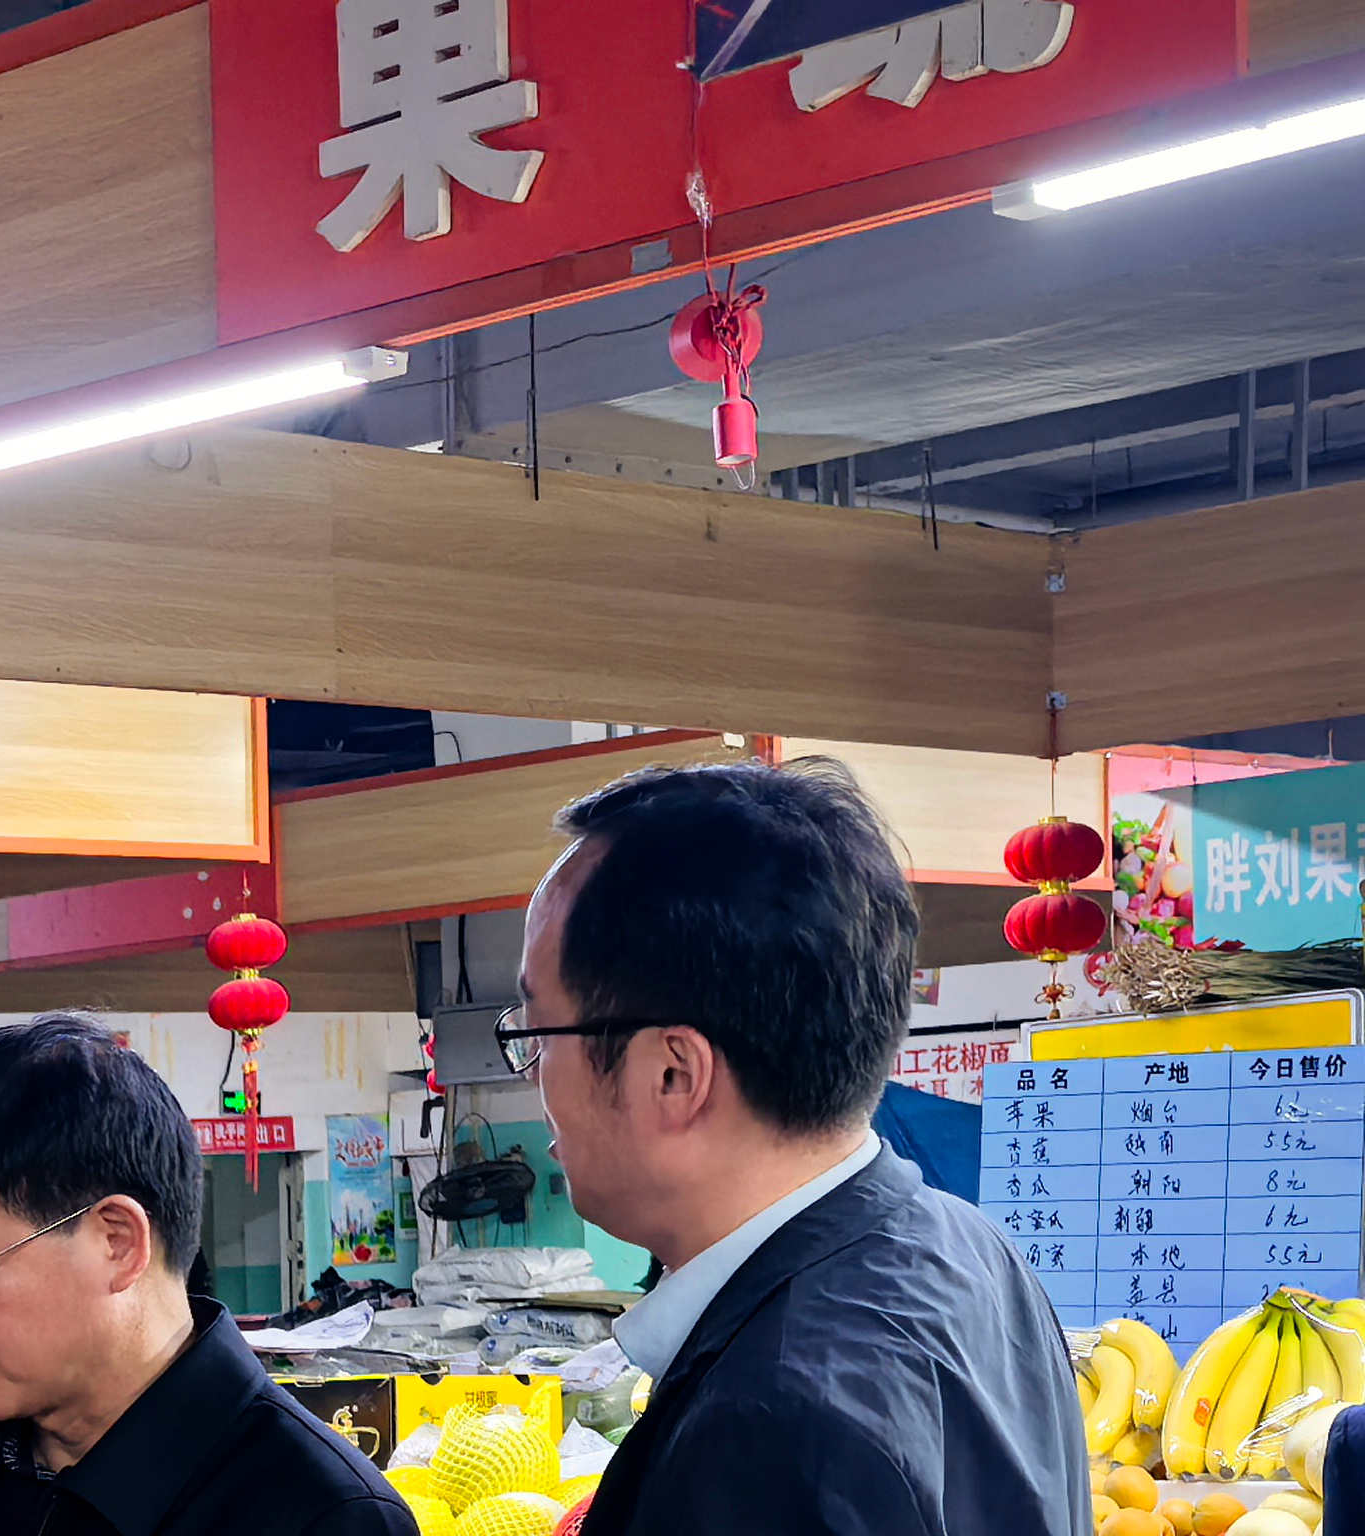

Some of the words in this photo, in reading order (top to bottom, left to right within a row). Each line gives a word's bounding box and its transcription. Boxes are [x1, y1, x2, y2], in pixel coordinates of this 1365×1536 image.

[1017, 1067, 1069, 1091] 品名
[1144, 1061, 1190, 1085] 产地
[1249, 1053, 1347, 1081] 今日售价
[1005, 1100, 1054, 1129] 苹果
[1131, 1099, 1177, 1124] 烟台
[1266, 1169, 1306, 1192] 8元
[1131, 1242, 1186, 1270] 本地
